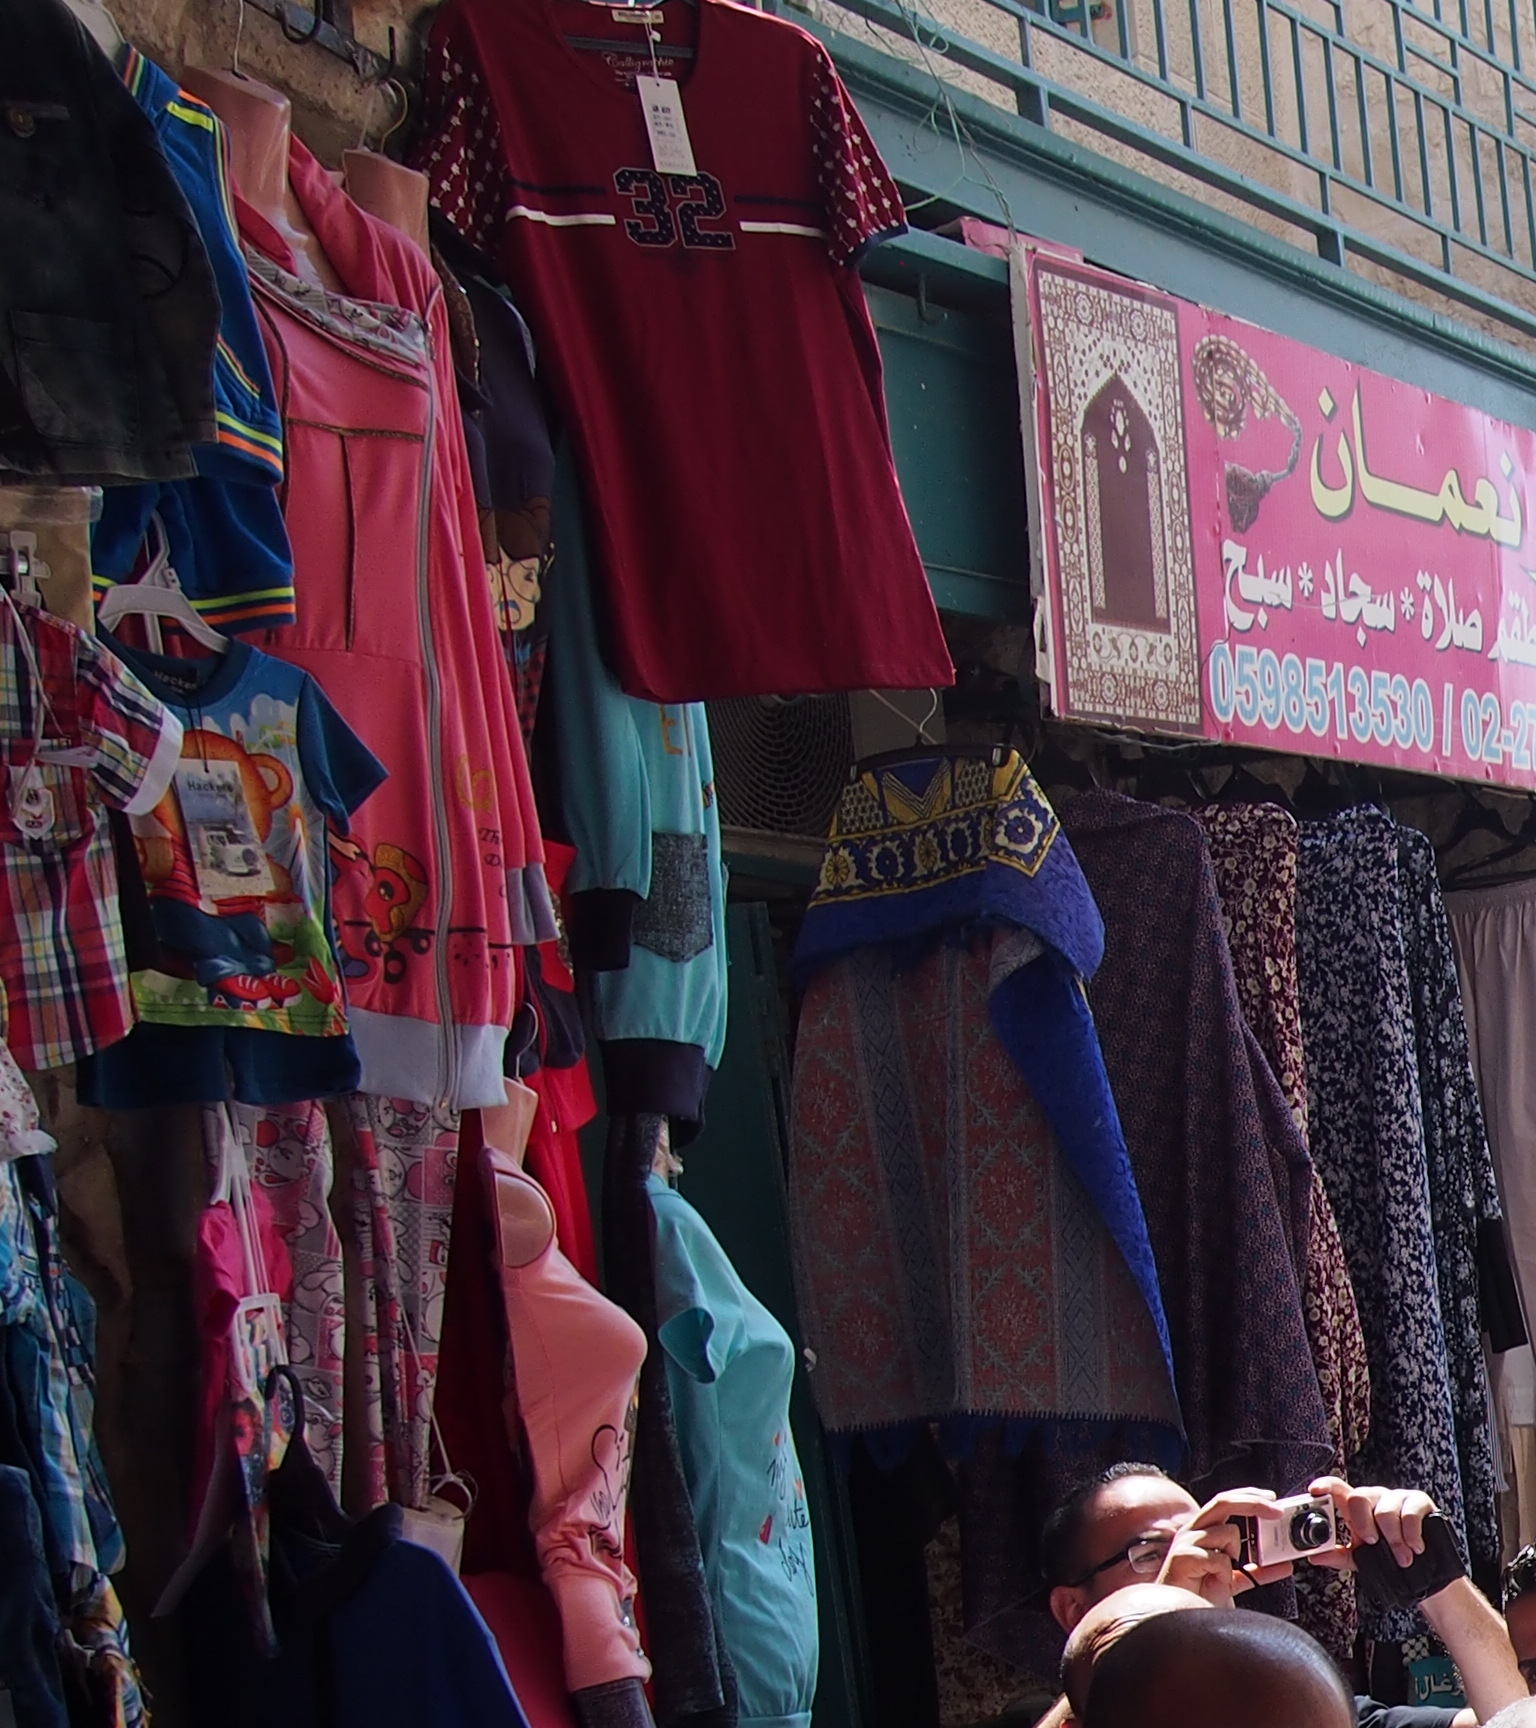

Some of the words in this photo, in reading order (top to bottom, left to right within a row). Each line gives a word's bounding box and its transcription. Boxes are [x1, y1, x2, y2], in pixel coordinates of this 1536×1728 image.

[613, 167, 736, 250] 32
[1310, 378, 1522, 549] نعمان
[1222, 539, 1293, 631] سبح
[1321, 547, 1395, 648] سجاد
[1416, 569, 1483, 651] صلاة
[1209, 640, 1435, 753] 0598513530
